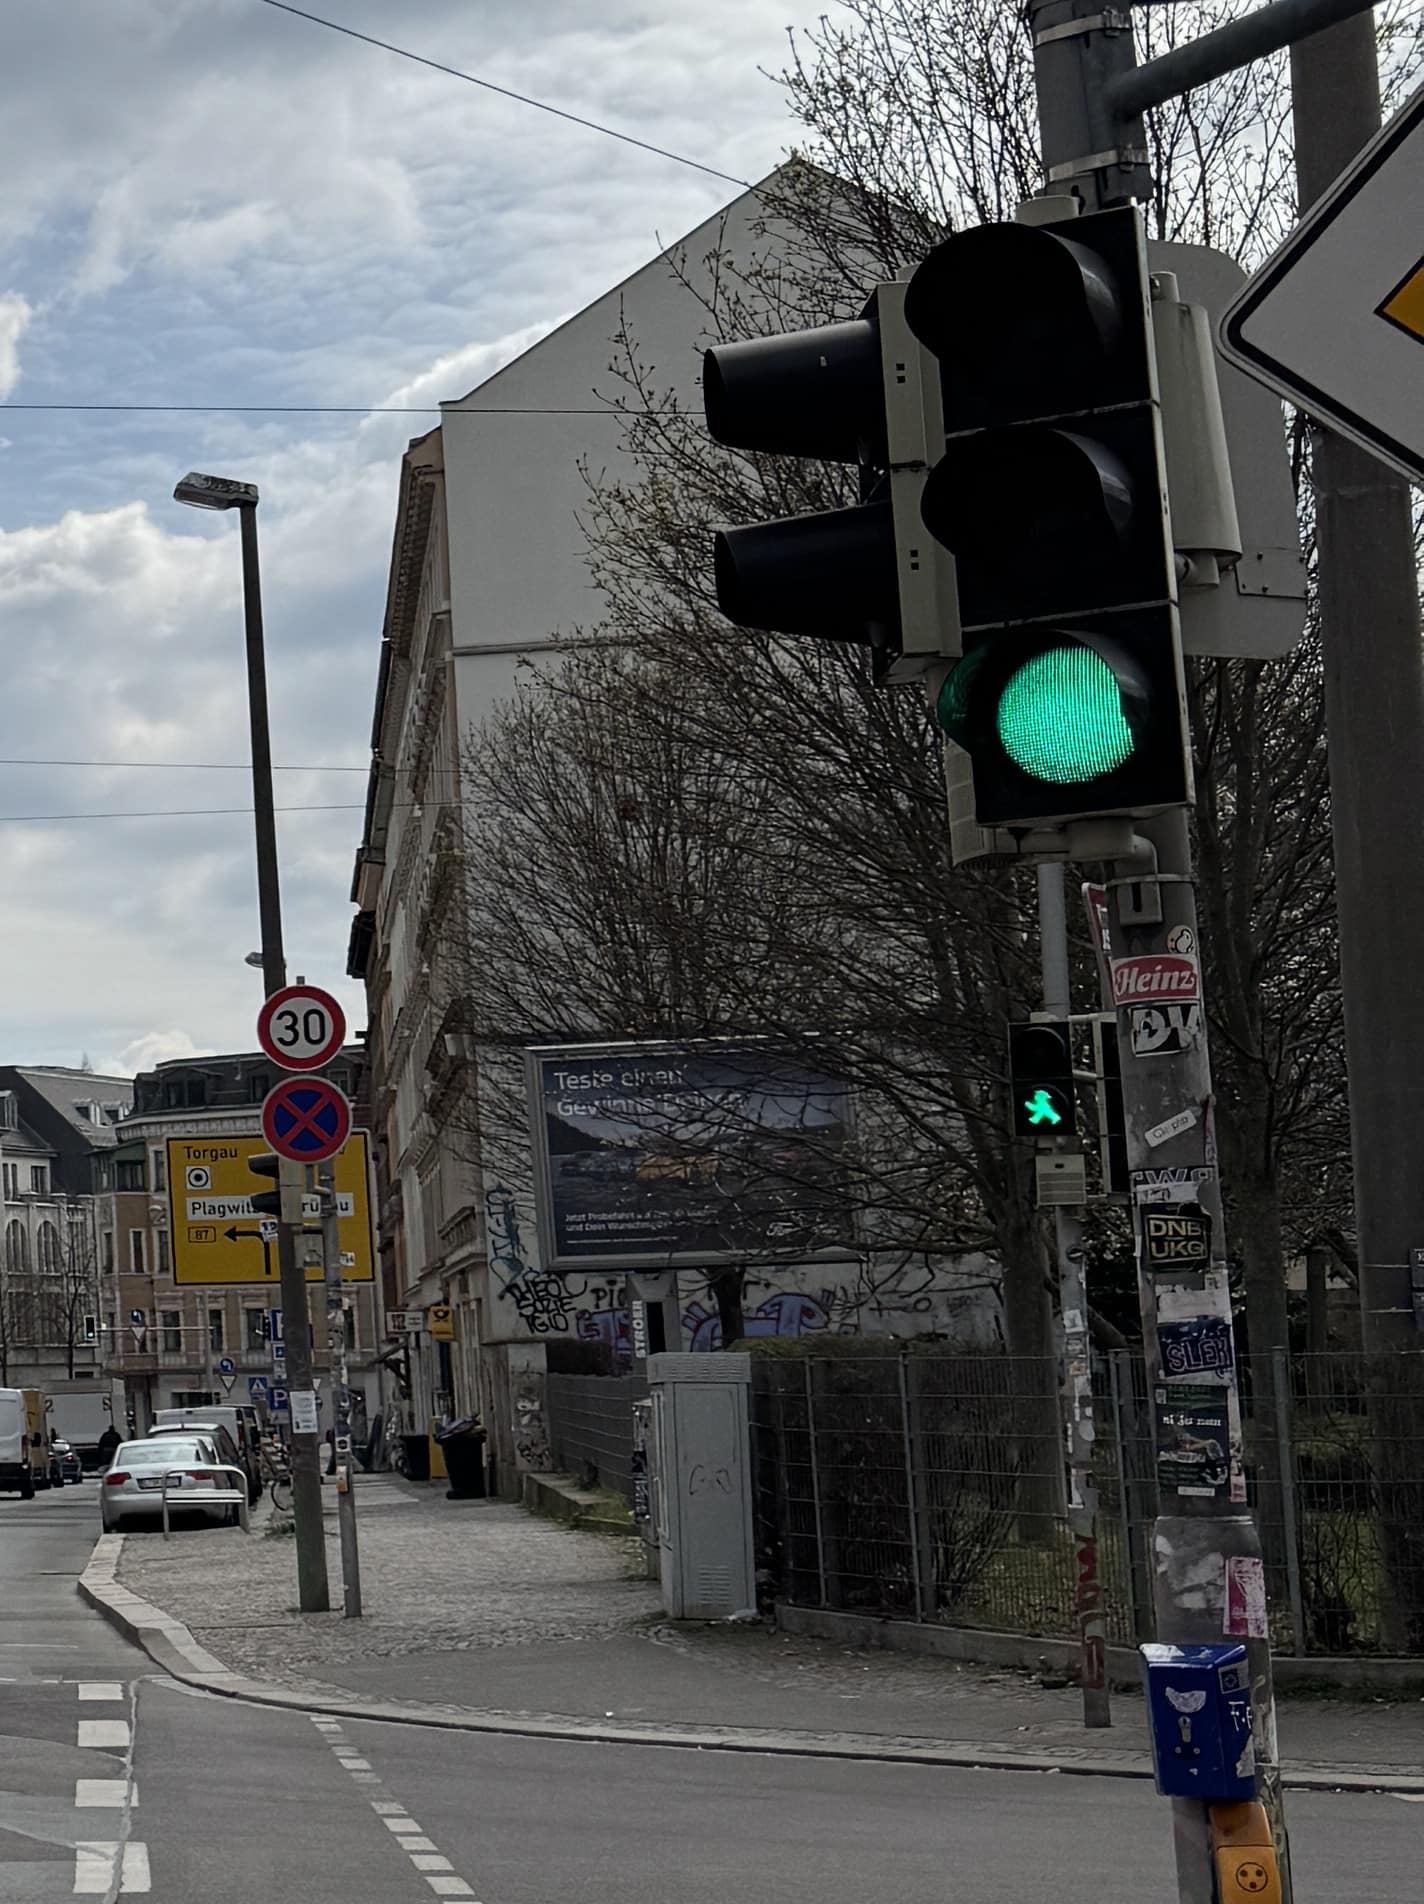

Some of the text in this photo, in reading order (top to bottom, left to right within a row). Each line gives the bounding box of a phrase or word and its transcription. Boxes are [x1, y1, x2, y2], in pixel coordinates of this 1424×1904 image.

[1116, 965, 1196, 996] Heinz
[276, 1008, 325, 1046] 30
[183, 1145, 238, 1162] Torgau
[191, 1201, 256, 1218] Plagwit
[195, 1230, 209, 1240] 87
[1149, 1218, 1202, 1238] DNB
[1151, 1239, 1204, 1259] UKG
